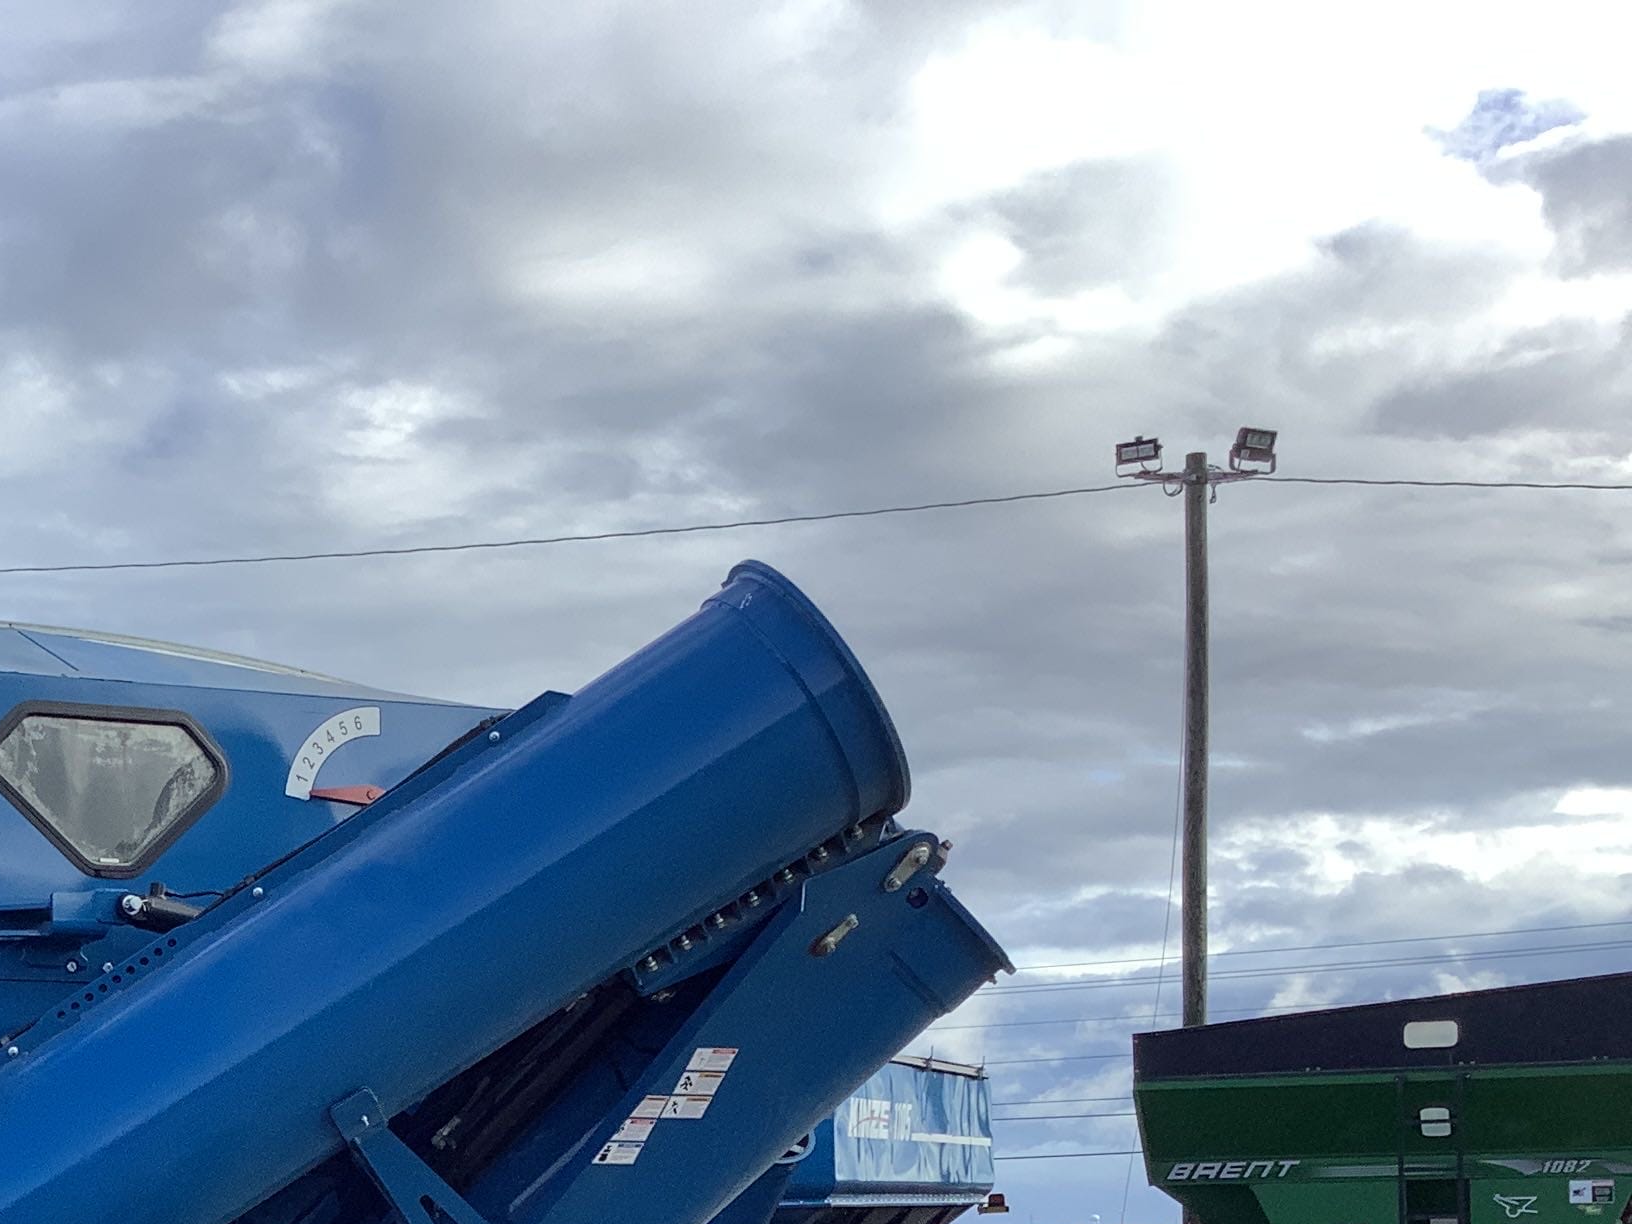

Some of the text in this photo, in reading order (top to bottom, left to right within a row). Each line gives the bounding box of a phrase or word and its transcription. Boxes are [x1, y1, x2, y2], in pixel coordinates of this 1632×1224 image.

[302, 756, 316, 770] 2
[312, 741, 324, 755] 3
[326, 729, 335, 743] 4
[338, 720, 348, 736] 5
[353, 715, 363, 731] 6
[1167, 1159, 1301, 1181] BRENT
[1542, 1158, 1593, 1174] 1082
